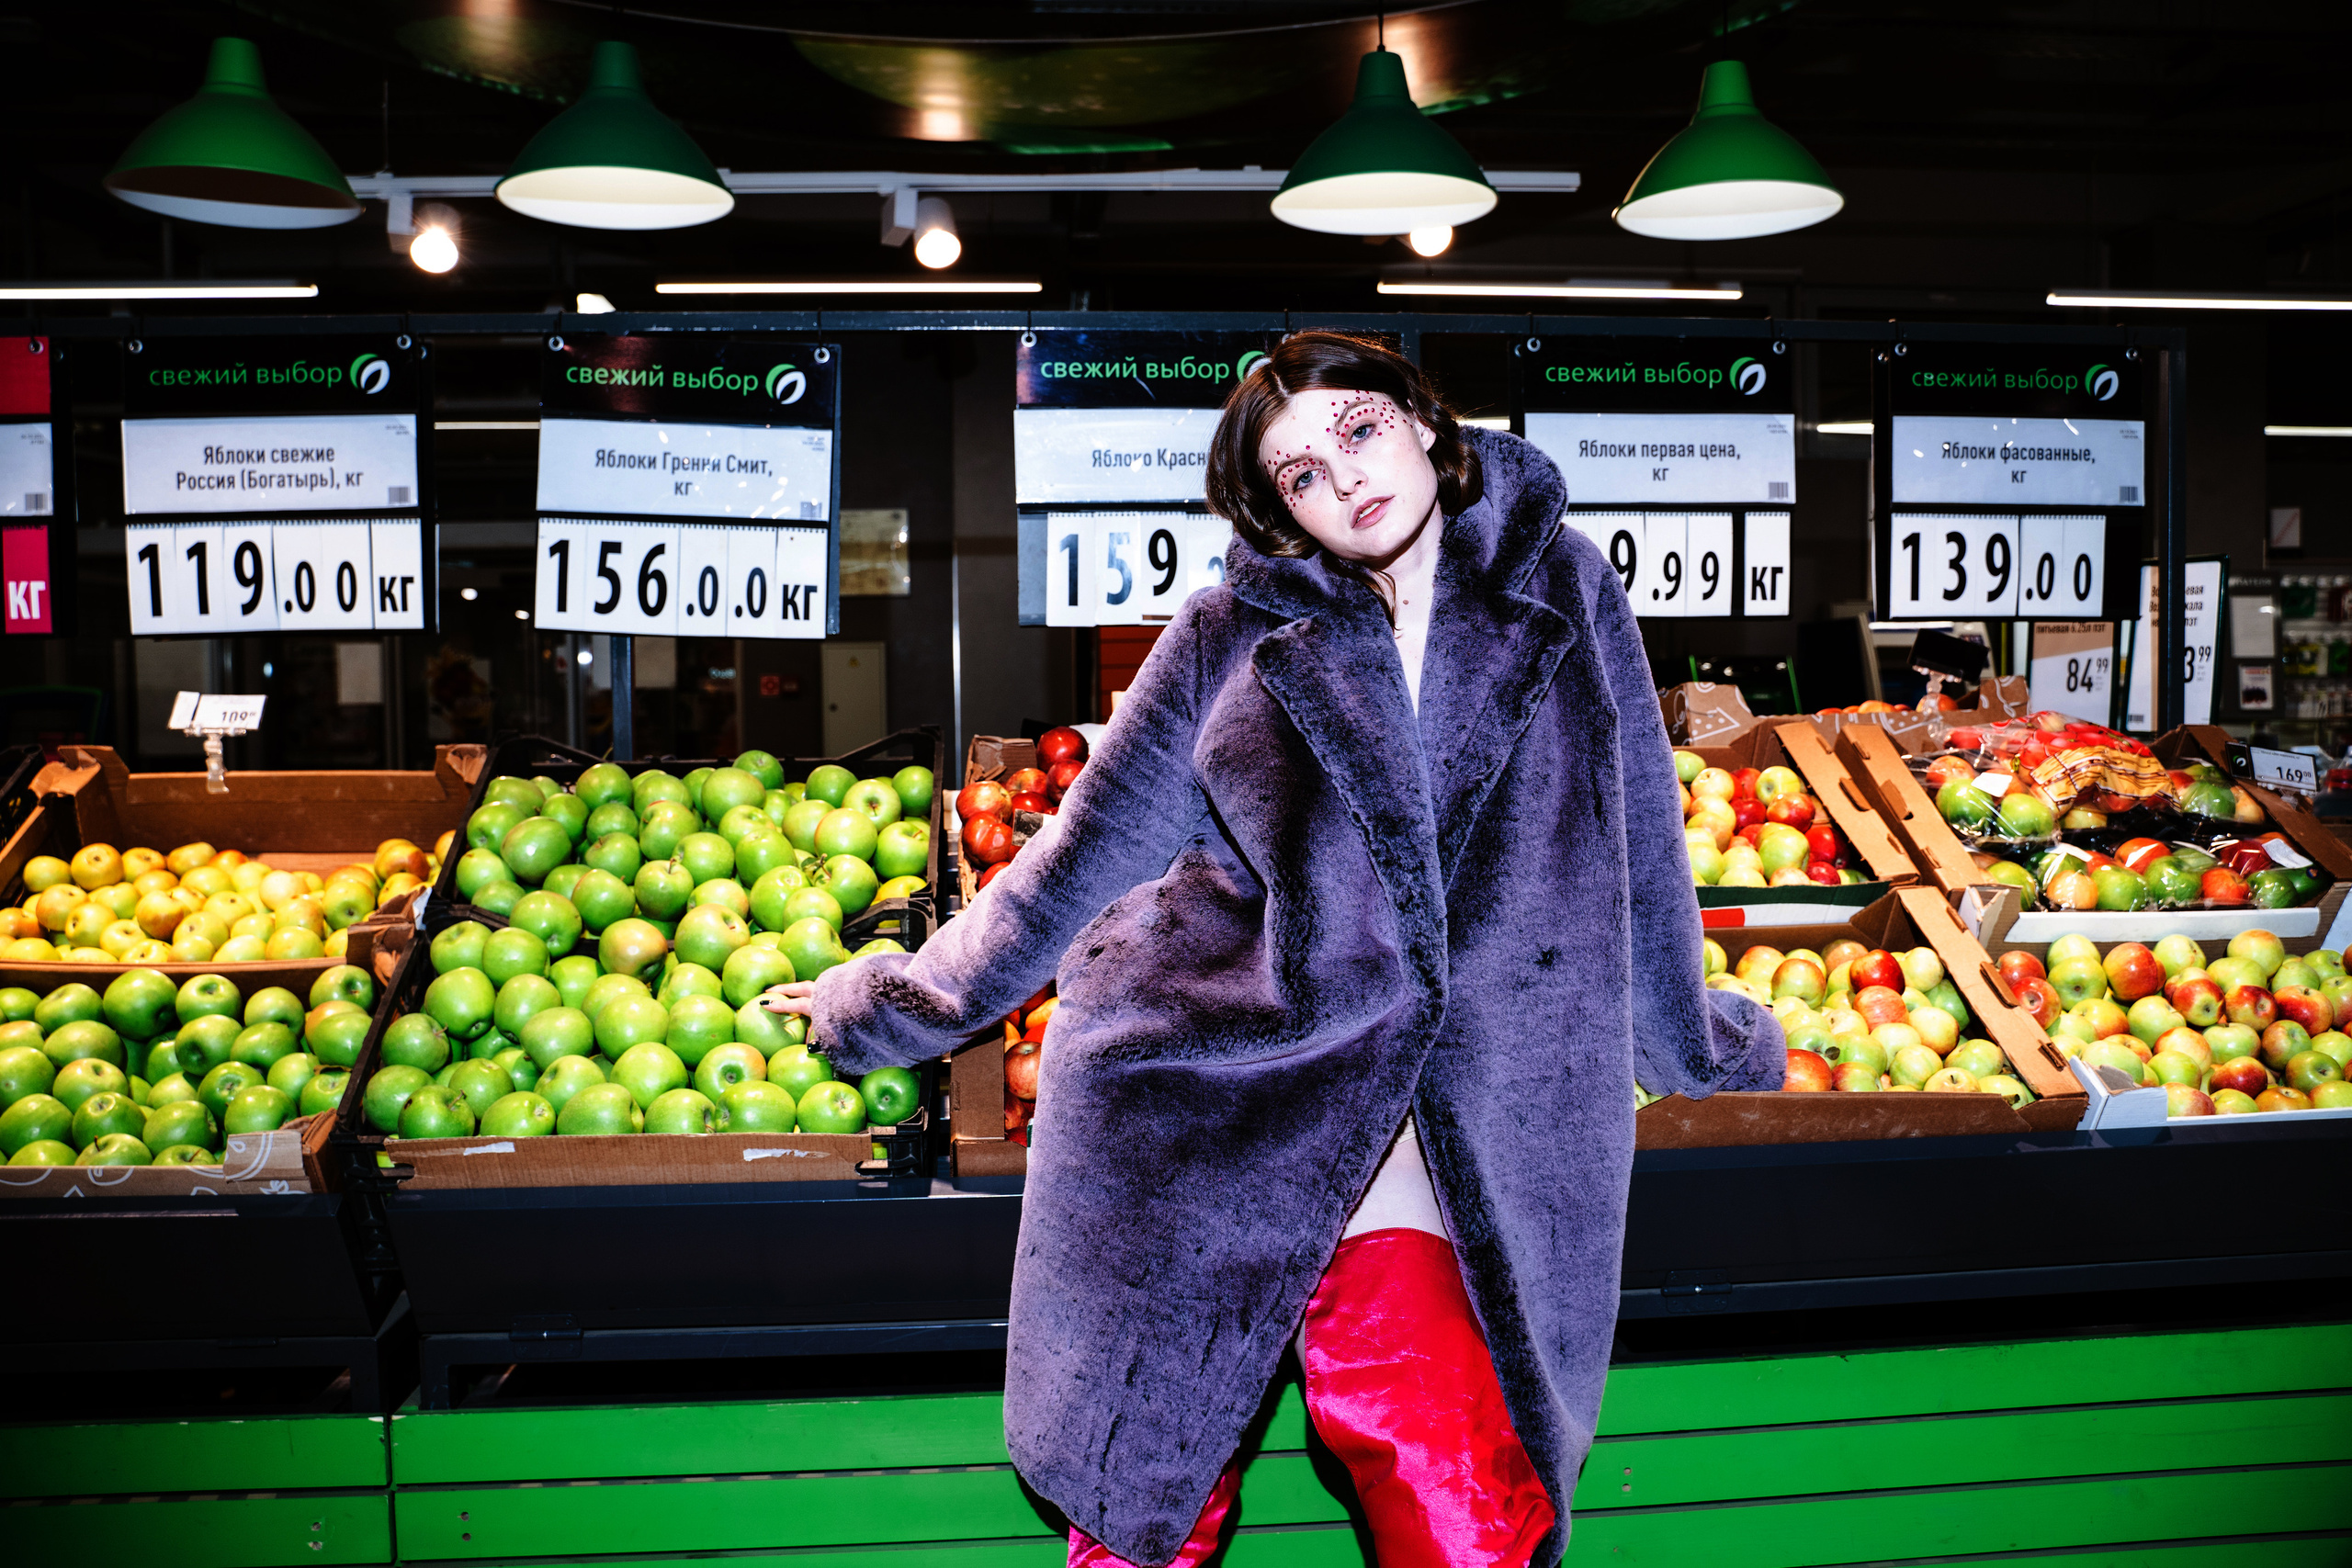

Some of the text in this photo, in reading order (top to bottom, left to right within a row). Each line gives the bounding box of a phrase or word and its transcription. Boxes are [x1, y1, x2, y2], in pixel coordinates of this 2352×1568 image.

[149, 361, 343, 388] свежий выбор
[566, 364, 759, 396] свежий выбор
[1041, 356, 1230, 384] свежий выбор
[1545, 362, 1723, 389] свежий выбор
[1912, 368, 2078, 395] свежий выбор
[203, 446, 335, 465] Яблоки свежие
[595, 449, 773, 478] Яблоки Гренни Смит,
[1158, 448, 1206, 470] Красн
[1578, 440, 1741, 462] Яблоки первая цена,
[1941, 442, 2096, 464] Яблоки фасованные,
[176, 470, 364, 492] Россия (Богатырь), кг
[1652, 468, 1669, 481] кг
[2011, 469, 2028, 484] кг
[673, 481, 693, 496] кг
[379, 576, 414, 613] кг
[1750, 566, 1784, 601] кг
[8, 580, 46, 620] кг
[782, 584, 818, 621] кг
